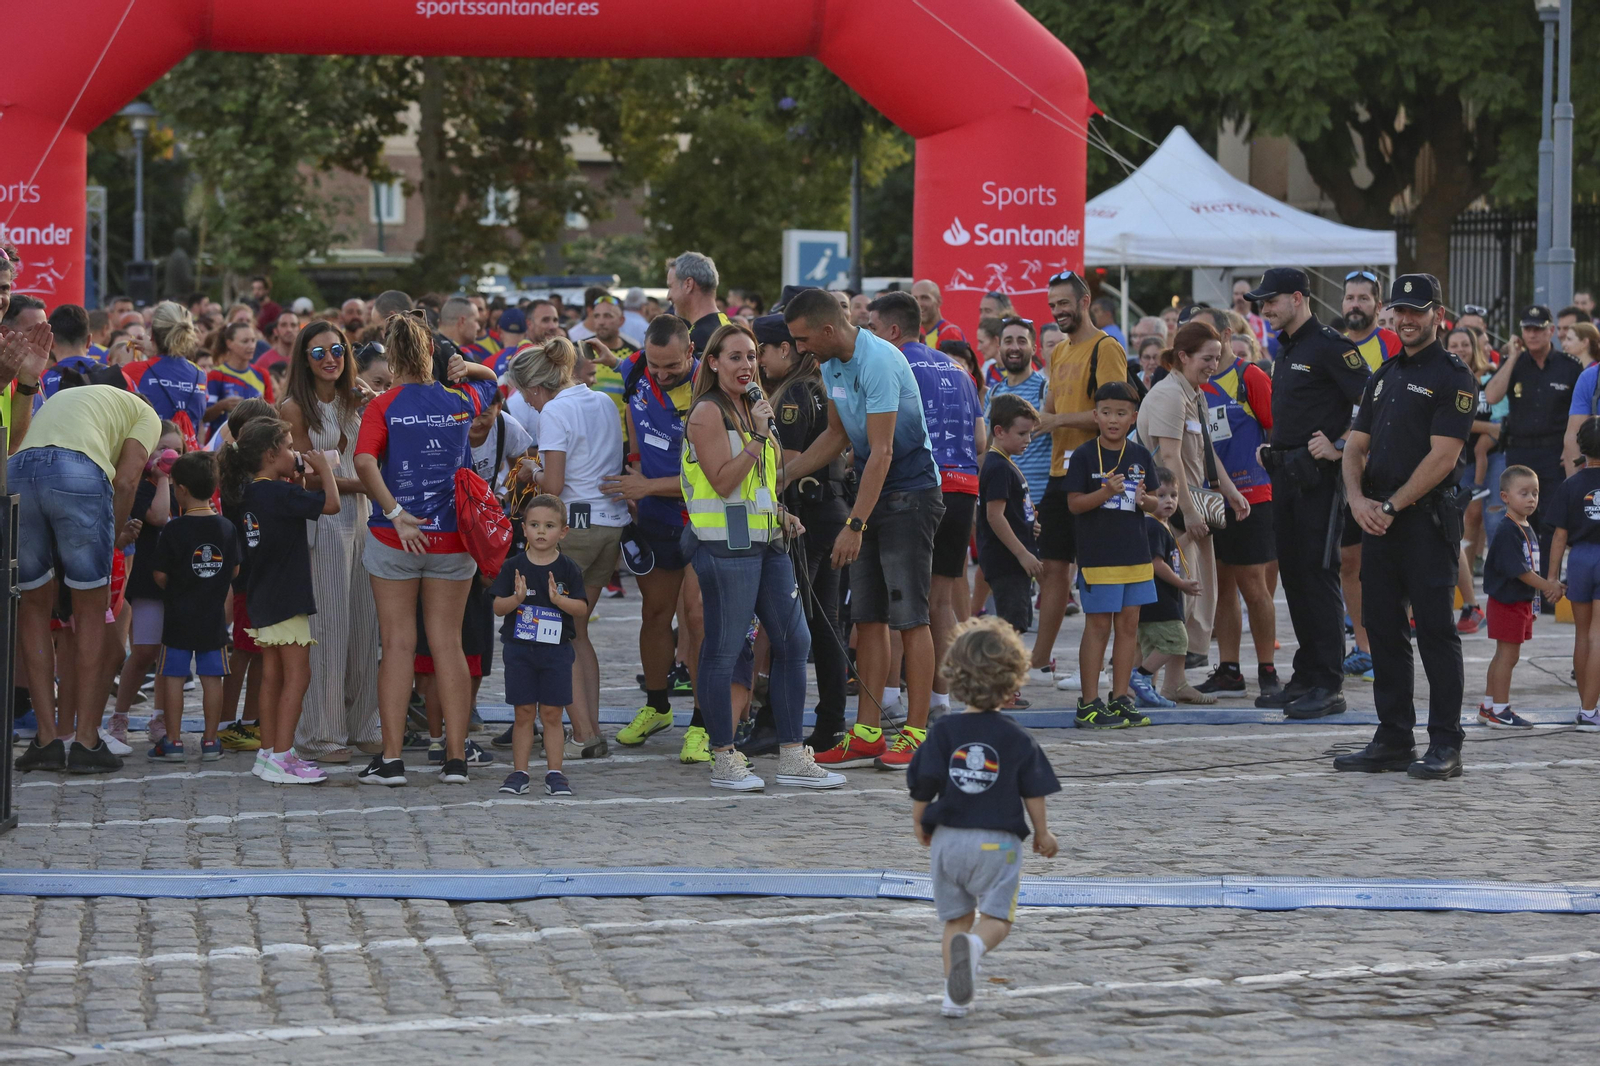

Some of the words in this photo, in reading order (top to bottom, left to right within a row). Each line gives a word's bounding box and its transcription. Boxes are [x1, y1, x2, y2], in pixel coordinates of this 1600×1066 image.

[415, 0, 600, 18] sportssantander.es
[981, 181, 1058, 211] Sports
[974, 223, 1081, 246] Santander
[541, 610, 563, 619] DORSAL
